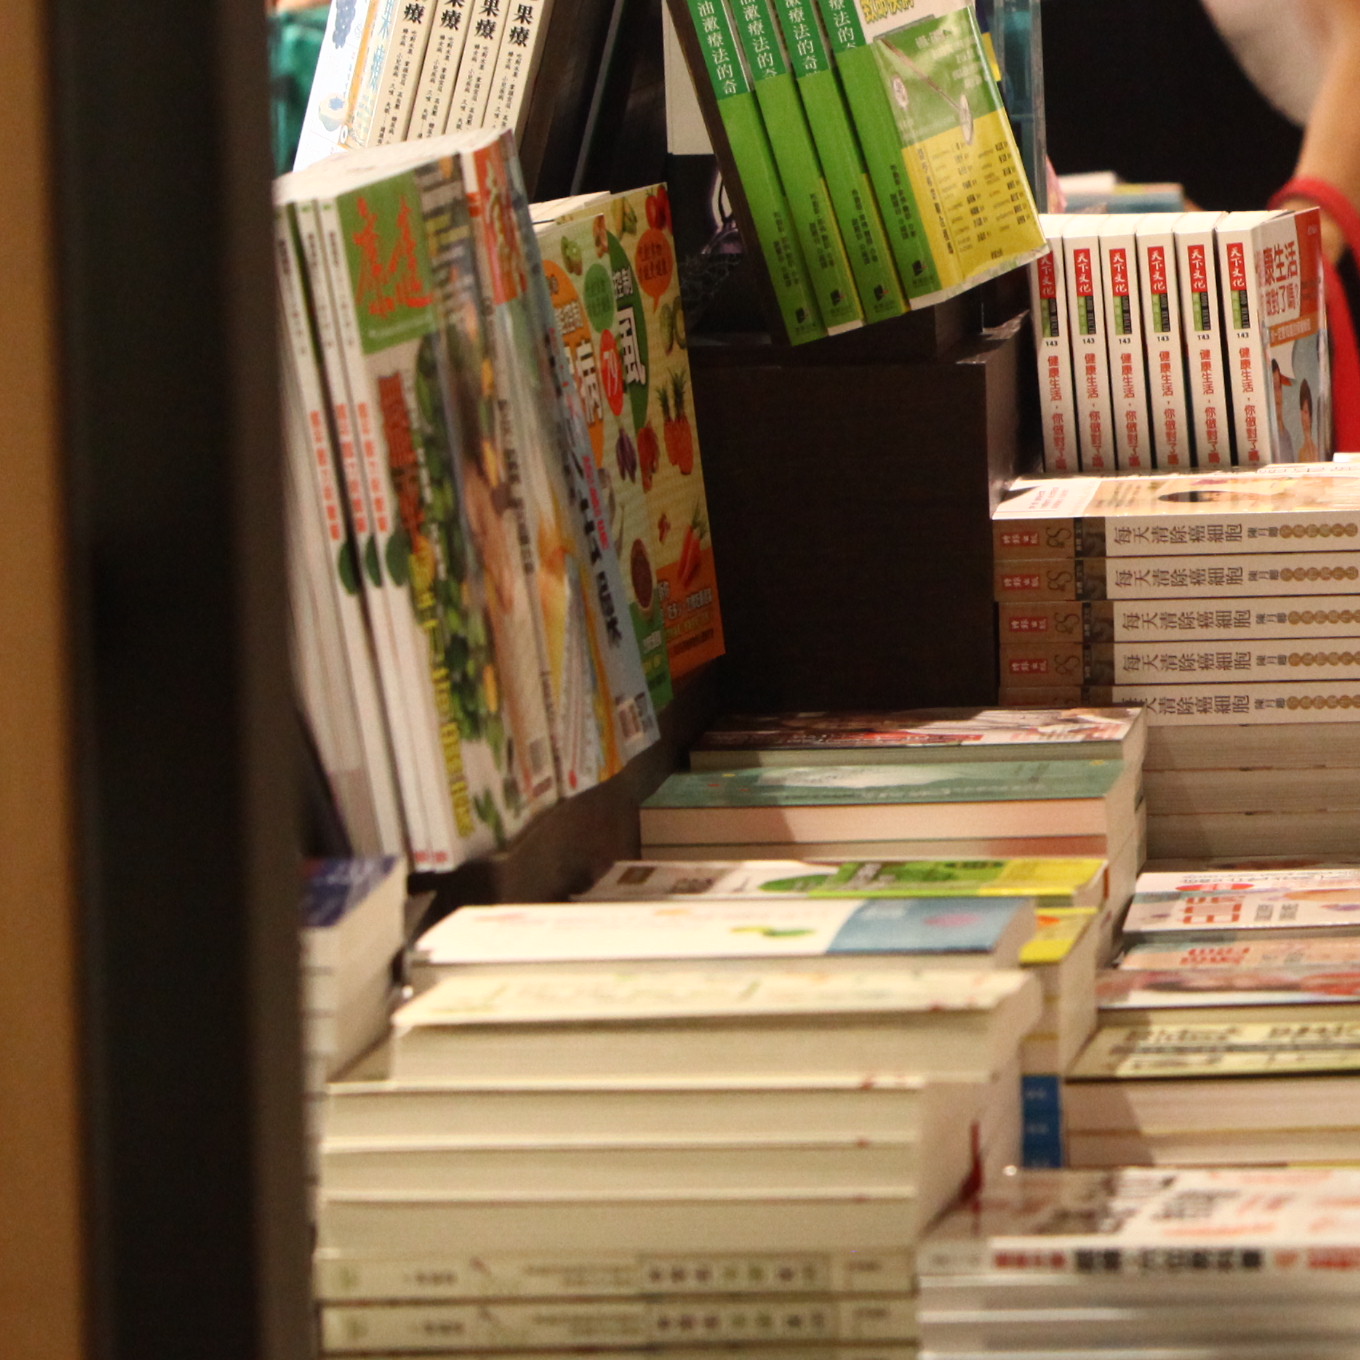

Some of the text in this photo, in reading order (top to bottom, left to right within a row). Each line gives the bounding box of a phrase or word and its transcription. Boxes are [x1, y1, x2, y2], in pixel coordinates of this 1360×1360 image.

[509, 4, 534, 48] 果療
[1076, 252, 1092, 294] 天下文化
[1112, 251, 1127, 293] 天下文化
[1151, 249, 1166, 291] 天下文化
[1190, 247, 1206, 289] 天下文化
[1230, 246, 1245, 287] 天下文化
[1045, 340, 1058, 348] 143
[1082, 337, 1095, 345] 143
[1118, 337, 1131, 345] 143
[1157, 335, 1170, 343] 143
[1197, 333, 1210, 341] 143
[1236, 332, 1249, 340] 143
[1114, 522, 1243, 546] 每天清除癌細胞
[1115, 566, 1244, 589] 每天清除癌細胞
[1122, 609, 1251, 632] 每天清除癌細胞
[1123, 650, 1251, 674] 每天清除癌細胞
